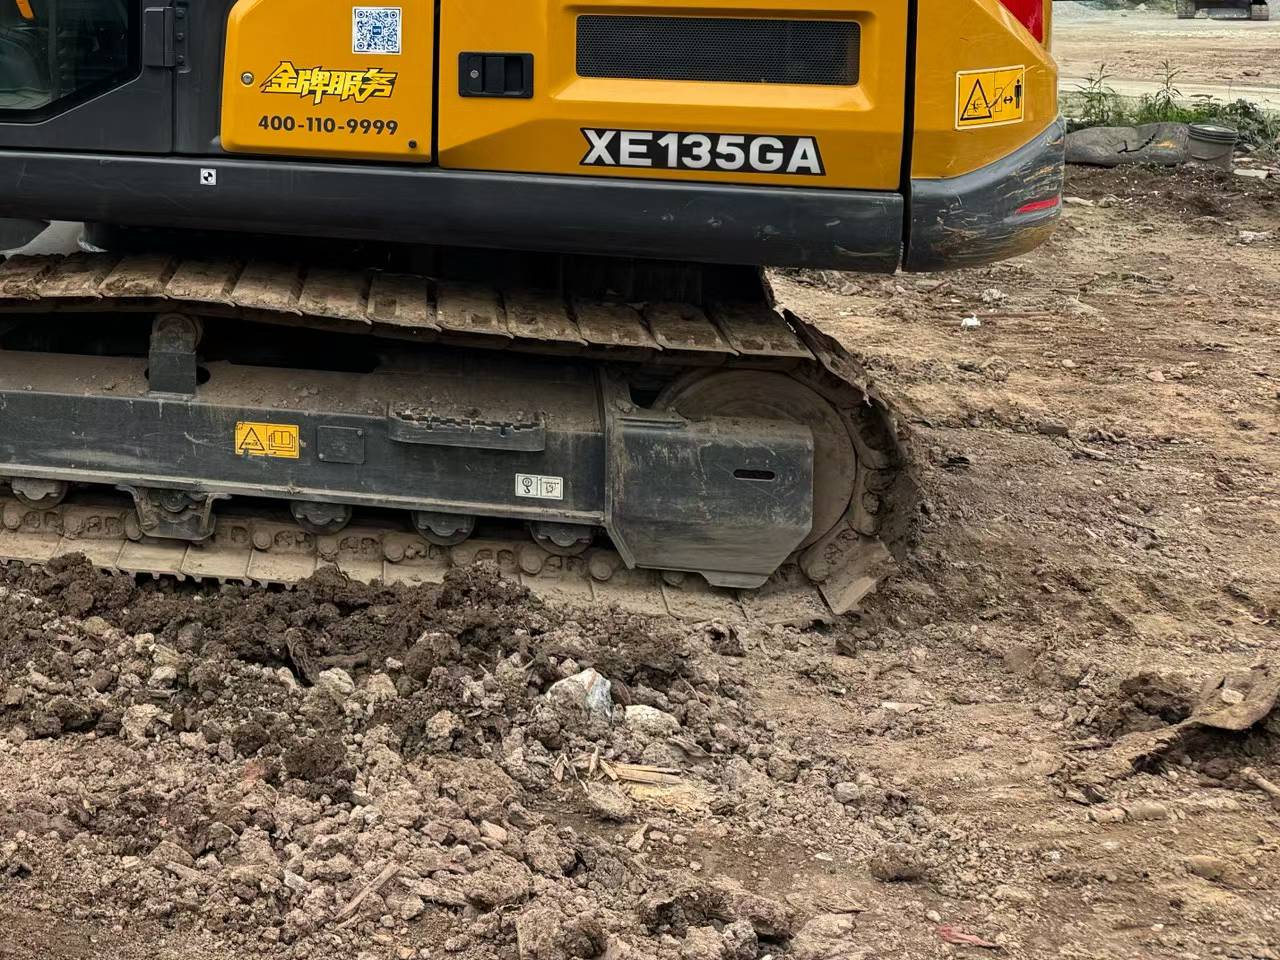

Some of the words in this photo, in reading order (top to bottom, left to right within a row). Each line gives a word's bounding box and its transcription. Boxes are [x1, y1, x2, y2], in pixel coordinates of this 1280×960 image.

[258, 60, 399, 106] 金牌服务
[257, 115, 399, 136] 400-110-9999
[582, 128, 822, 175] XE135GA
